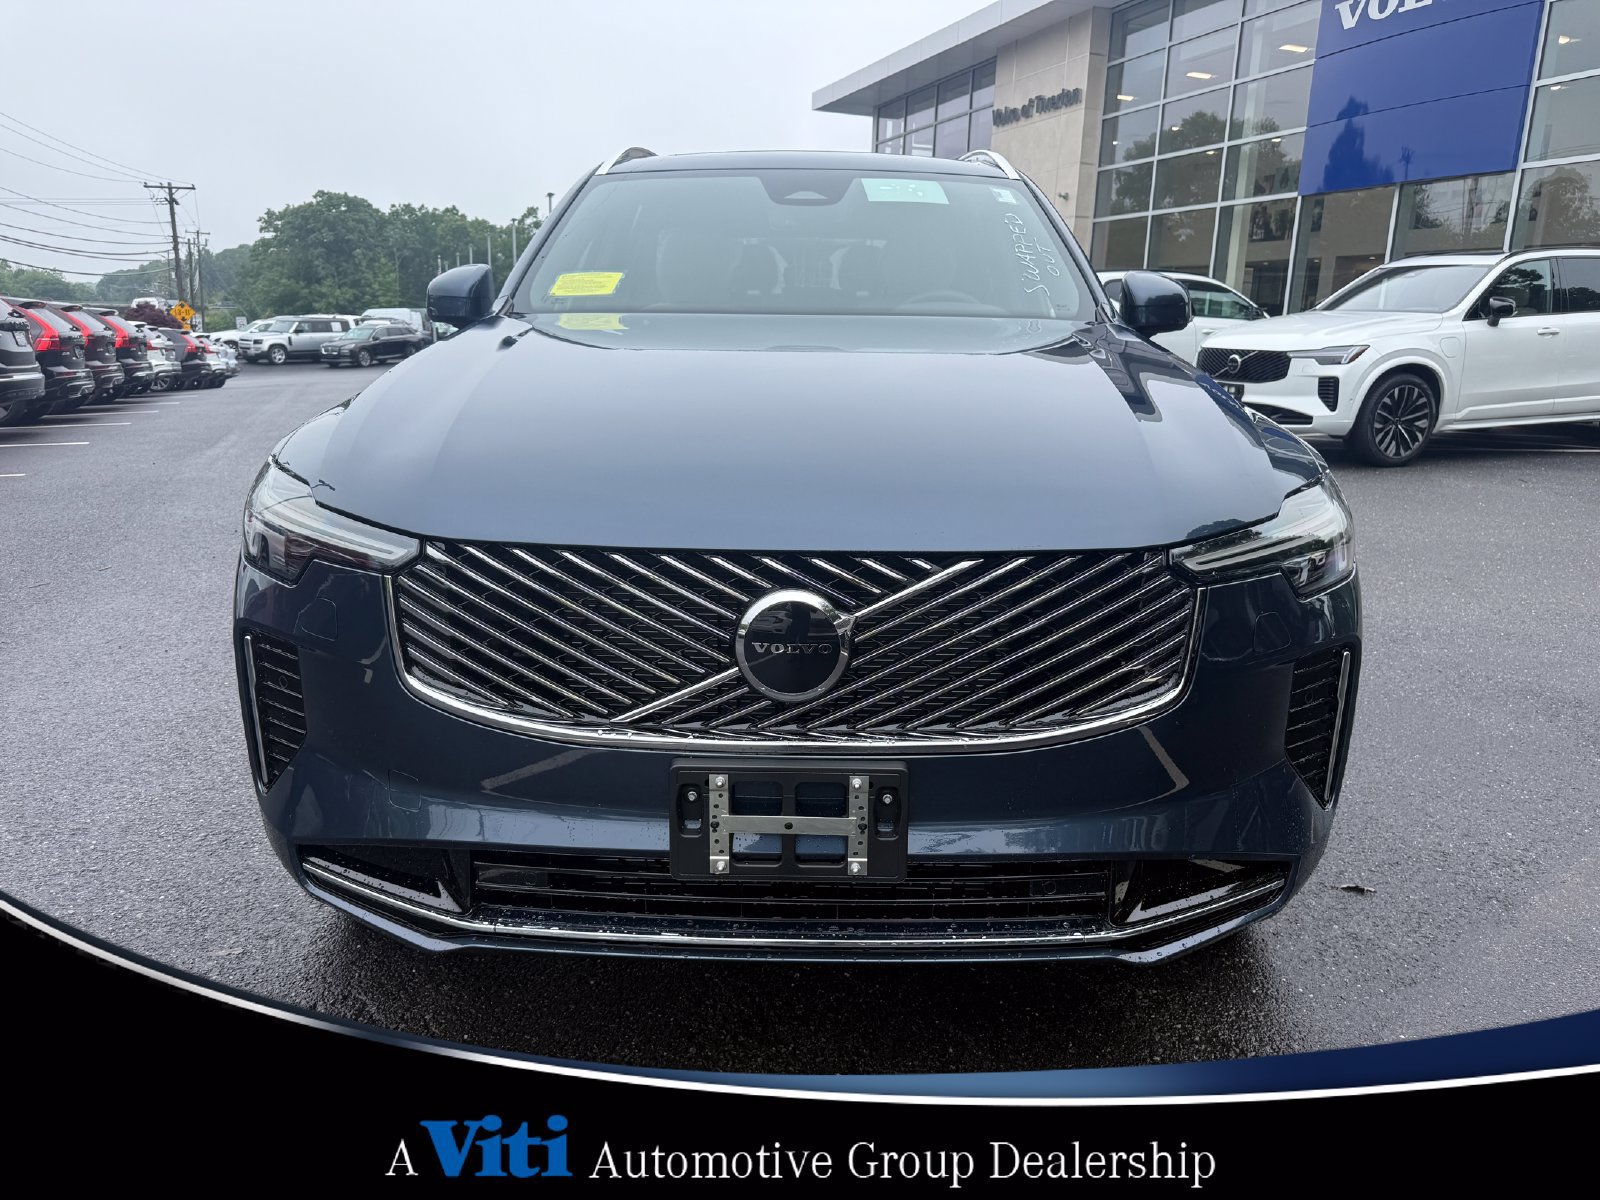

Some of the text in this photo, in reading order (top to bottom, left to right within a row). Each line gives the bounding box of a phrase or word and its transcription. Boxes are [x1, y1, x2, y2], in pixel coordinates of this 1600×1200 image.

[1004, 213, 1050, 297] SWAPPED
[1034, 237, 1060, 277] OUT
[751, 642, 833, 655] VOLVO
